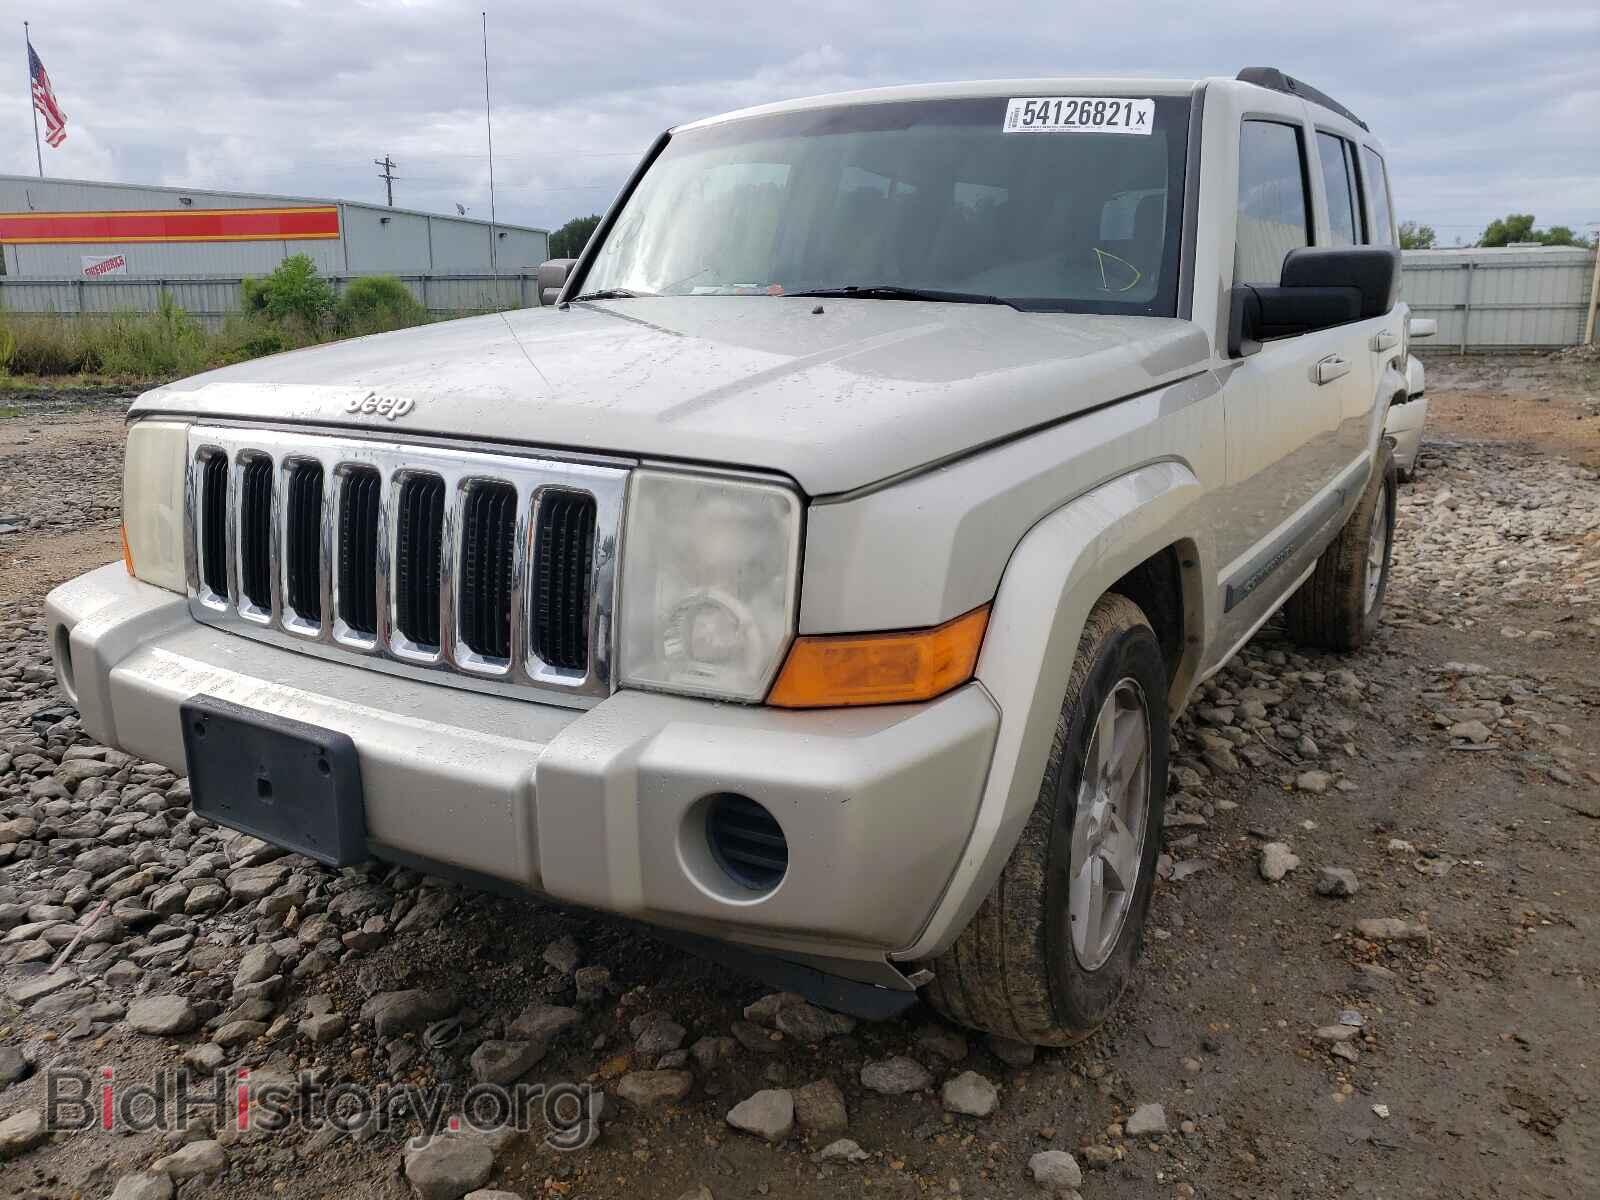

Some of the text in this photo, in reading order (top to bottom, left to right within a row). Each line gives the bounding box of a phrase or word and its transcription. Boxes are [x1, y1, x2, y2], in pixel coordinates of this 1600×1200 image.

[1022, 100, 1134, 127] 54126821
[84, 255, 125, 276] FIREWORKS
[344, 391, 416, 421] Jeep
